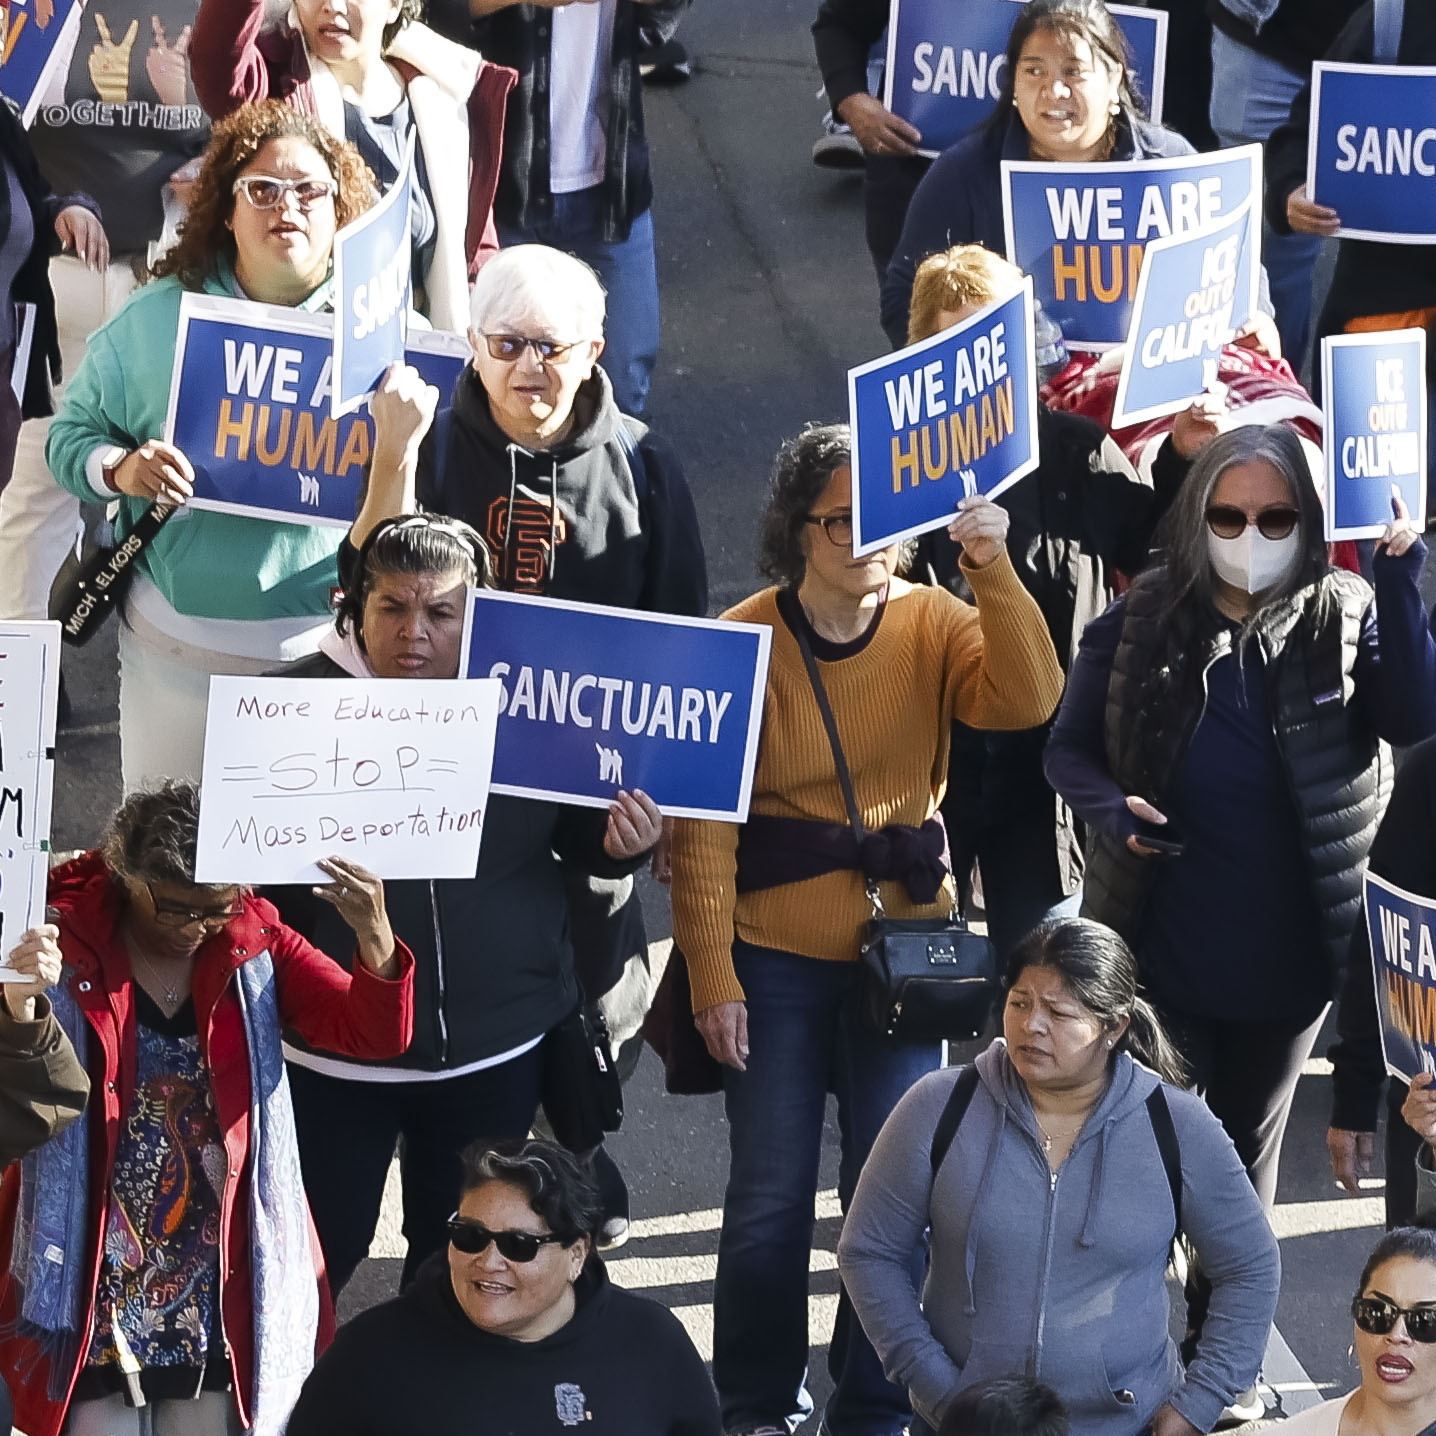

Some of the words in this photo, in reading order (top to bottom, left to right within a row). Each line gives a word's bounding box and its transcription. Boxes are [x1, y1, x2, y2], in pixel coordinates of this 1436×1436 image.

[33, 99, 202, 130] OGETHER
[1046, 187, 1125, 241] WE
[1136, 178, 1222, 239] ARE
[224, 339, 298, 401] WE
[884, 369, 946, 430] WE
[951, 322, 1008, 397] ARE
[213, 399, 373, 476] HUMA
[889, 377, 1015, 494] HUMAN
[65, 571, 116, 635] MICHEL
[109, 534, 142, 573] KORS
[237, 695, 311, 723] More
[334, 697, 480, 724] Education
[490, 662, 733, 744] SANCTUARY
[223, 816, 311, 850] Mass
[320, 809, 485, 845] Deportation
[1377, 903, 1415, 973] WE
